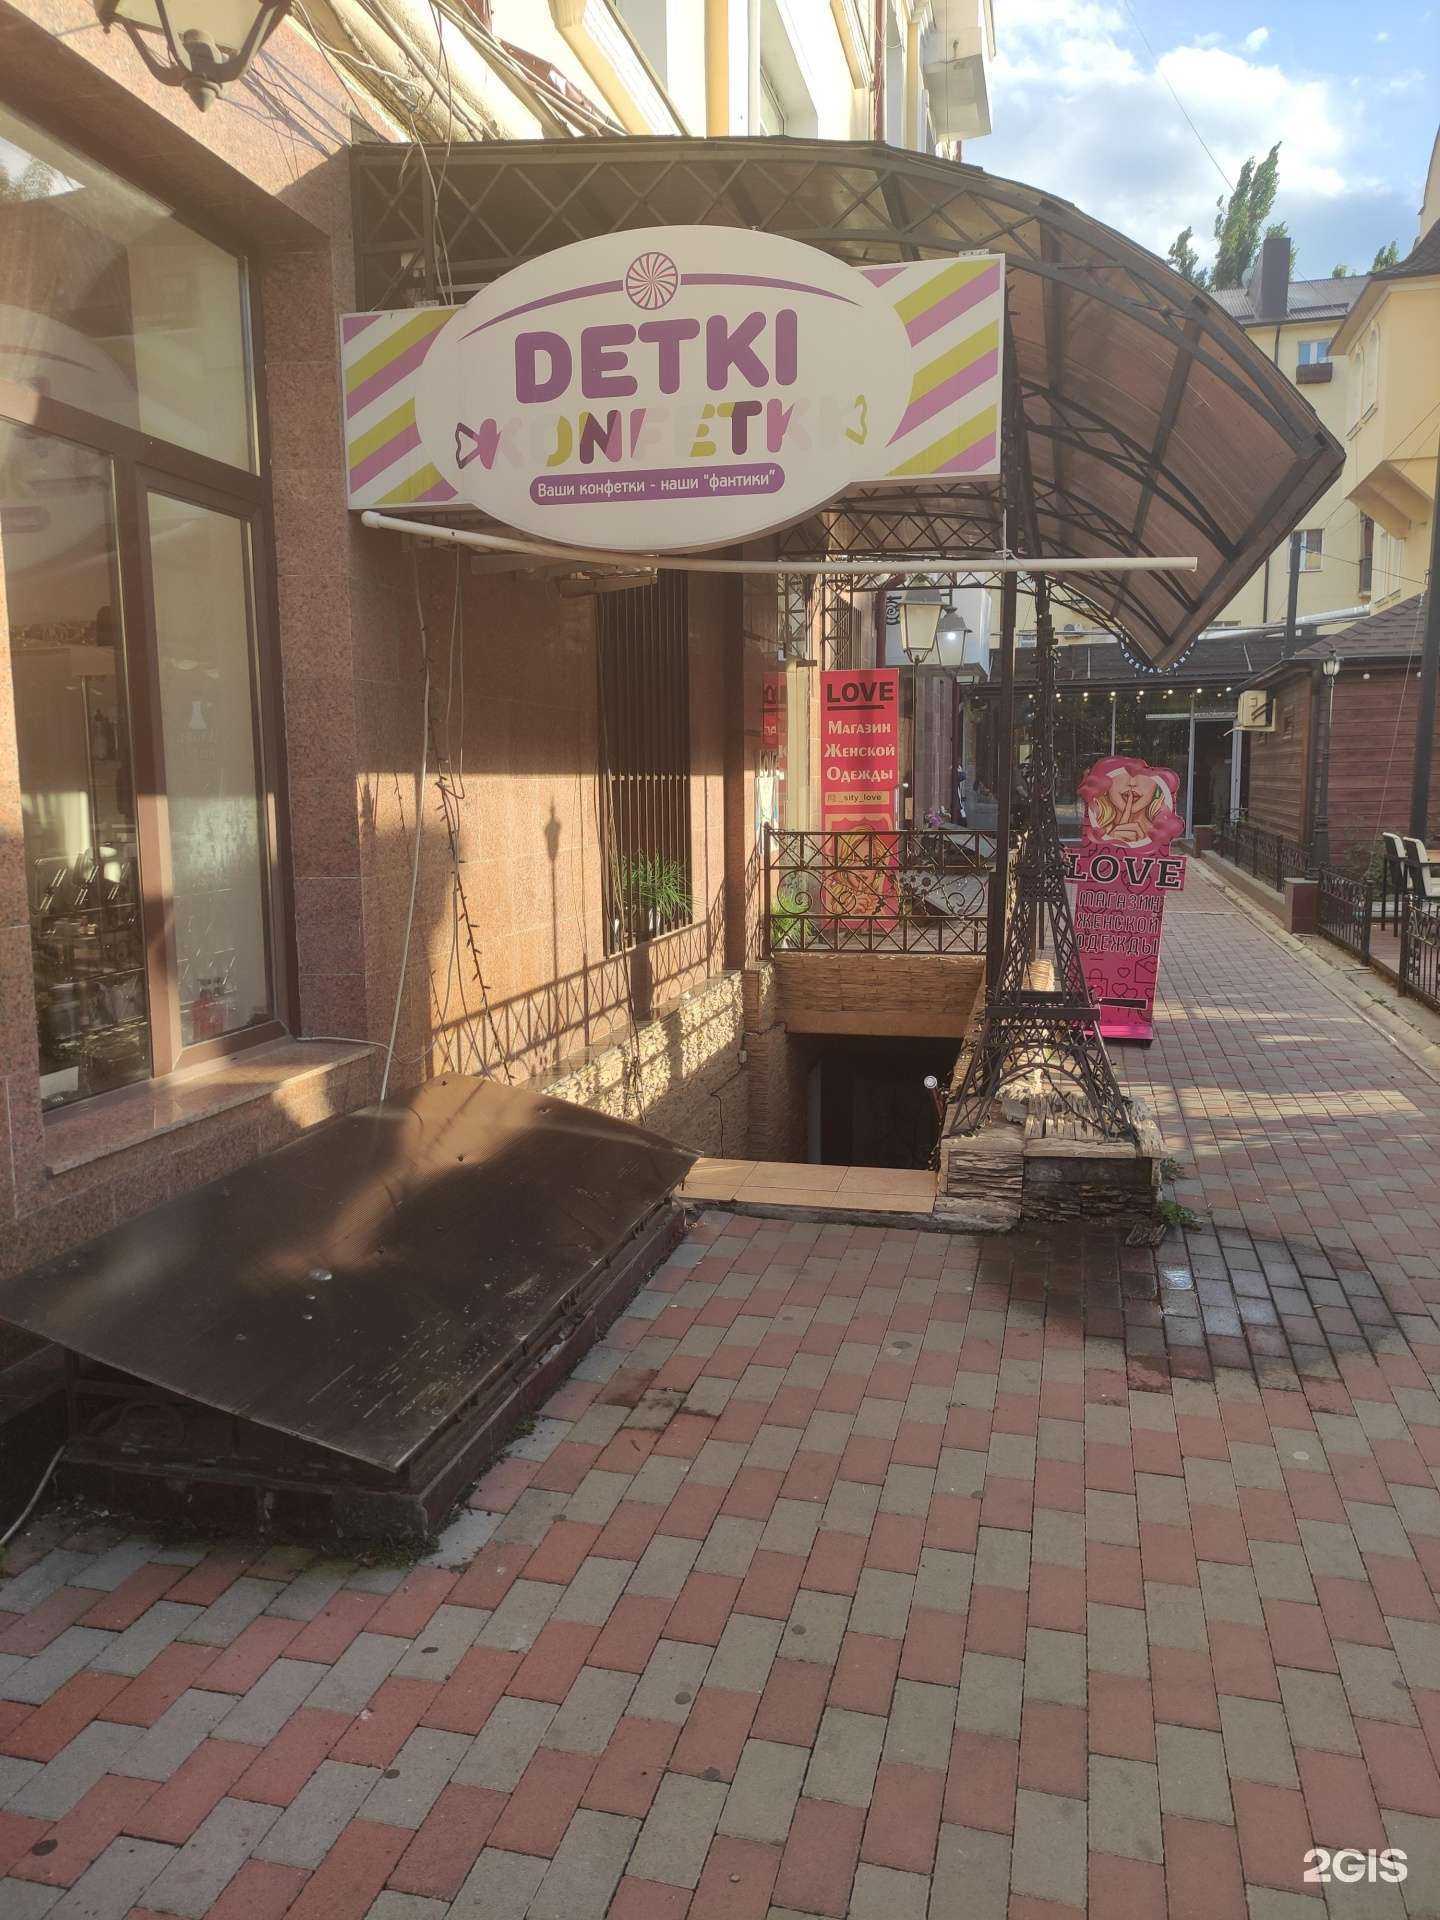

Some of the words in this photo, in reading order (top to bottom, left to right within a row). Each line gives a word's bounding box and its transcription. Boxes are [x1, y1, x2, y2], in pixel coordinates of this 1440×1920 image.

[515, 309, 798, 404] DETKI
[538, 482, 575, 498] Ваши
[579, 478, 645, 497] конфетки
[660, 475, 699, 491] наши
[826, 681, 895, 703] LOVE
[1065, 853, 1184, 890] LOVE
[1076, 912, 1160, 935] ЖЕНСКОЙ
[1076, 933, 1159, 958] ОДЕЖДЫ
